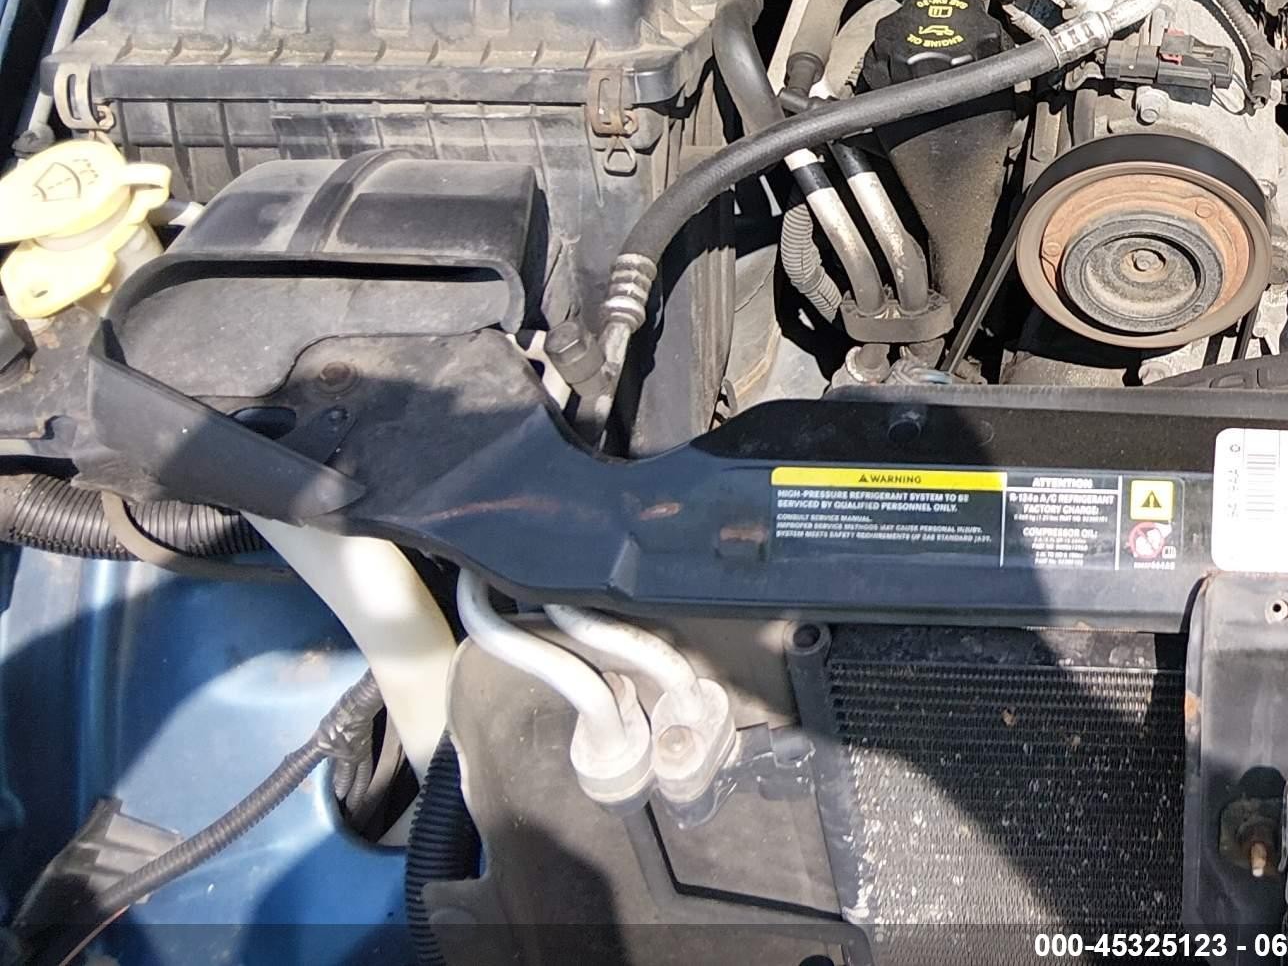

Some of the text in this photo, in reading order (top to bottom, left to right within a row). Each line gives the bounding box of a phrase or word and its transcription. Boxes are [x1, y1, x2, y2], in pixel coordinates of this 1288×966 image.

[906, 33, 964, 48] ENGINE OIL
[870, 474, 922, 485] WARNING
[1031, 477, 1094, 489] ATTENTION
[777, 489, 970, 503] HIGH-PRESSURE REFRIGERANT SYSTEM TO BE
[1008, 493, 1116, 506] R-134a A/C REFRIGERANT
[777, 499, 958, 513] SERVICED BY QUALIFIED PERSONNEL ONLY.
[1023, 504, 1100, 516] FACTORY CHARGE:
[776, 513, 810, 522] CONSULT
[810, 514, 840, 522] SERVICE
[813, 522, 843, 531] SERVICE
[919, 525, 956, 533] PERSONAL
[1022, 527, 1081, 538] COMPRESSOR
